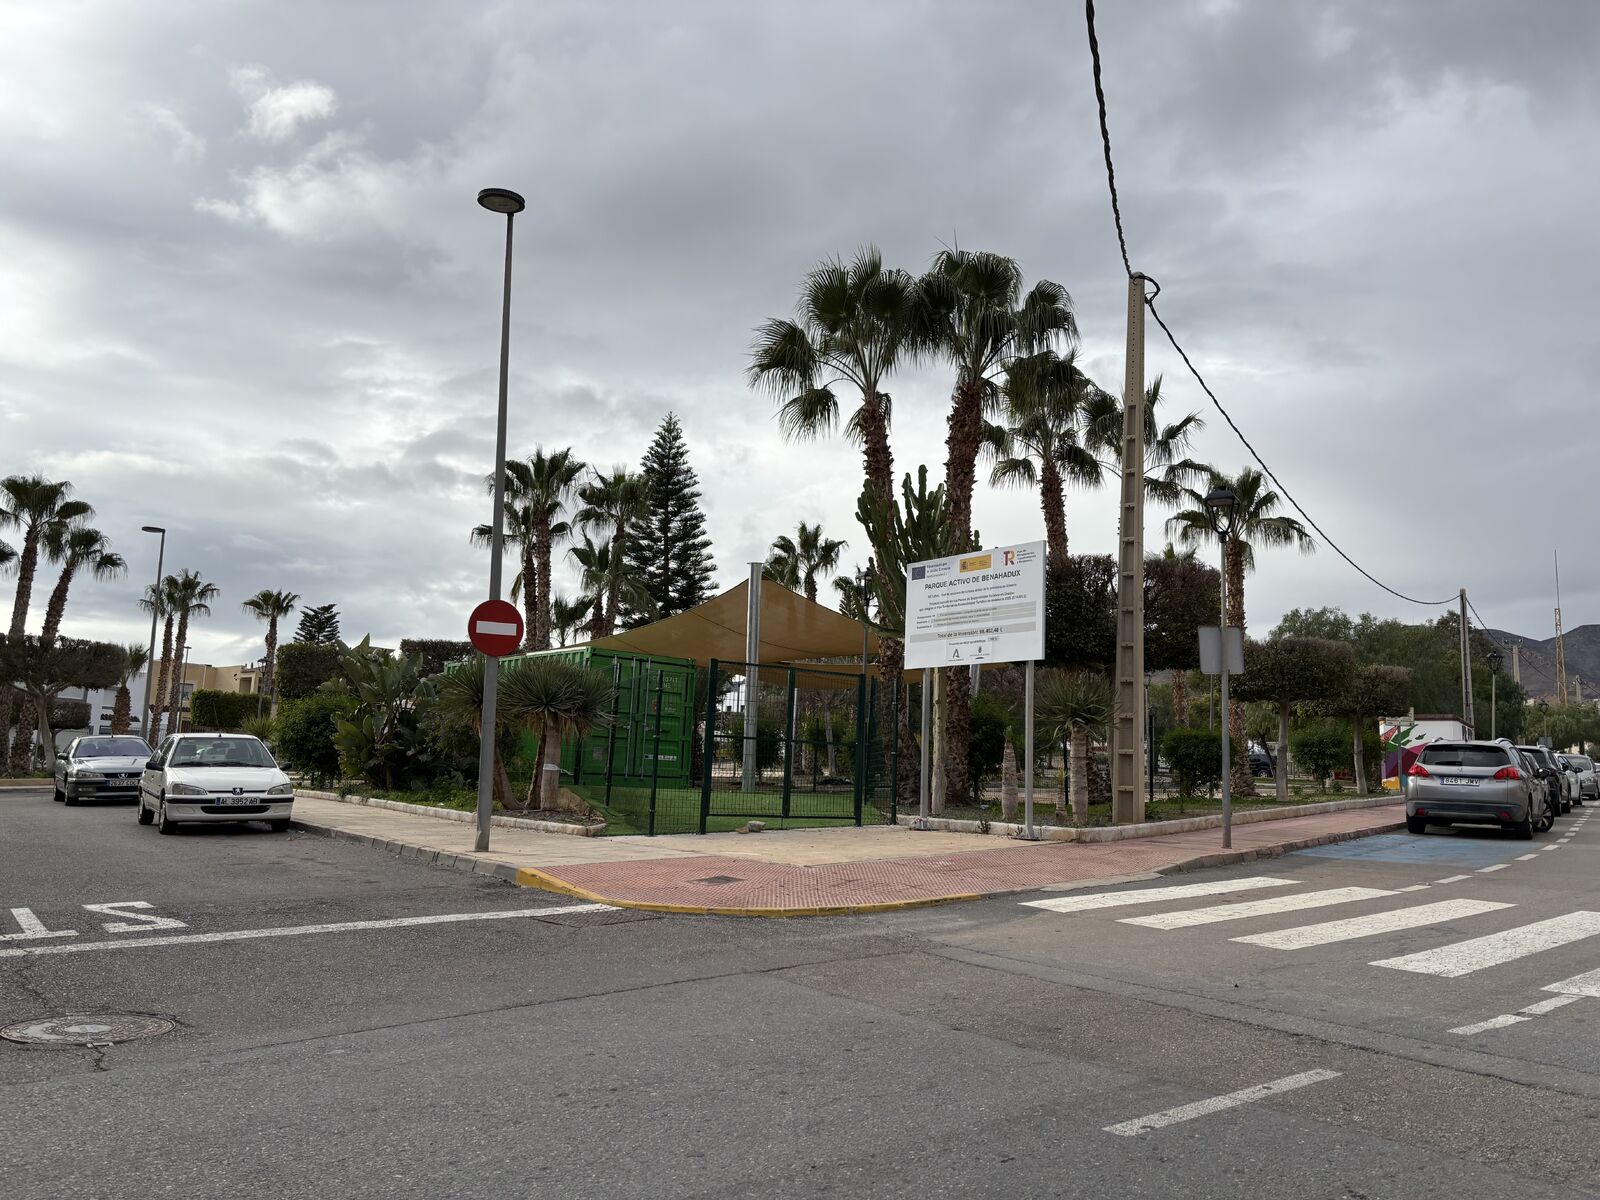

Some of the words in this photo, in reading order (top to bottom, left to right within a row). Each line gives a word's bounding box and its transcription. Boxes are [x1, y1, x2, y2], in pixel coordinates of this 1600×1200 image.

[924, 580, 948, 590] PARQUE
[948, 577, 971, 587] ACTIVO
[971, 575, 980, 583] DE
[981, 569, 1021, 582] BENAHADUX
